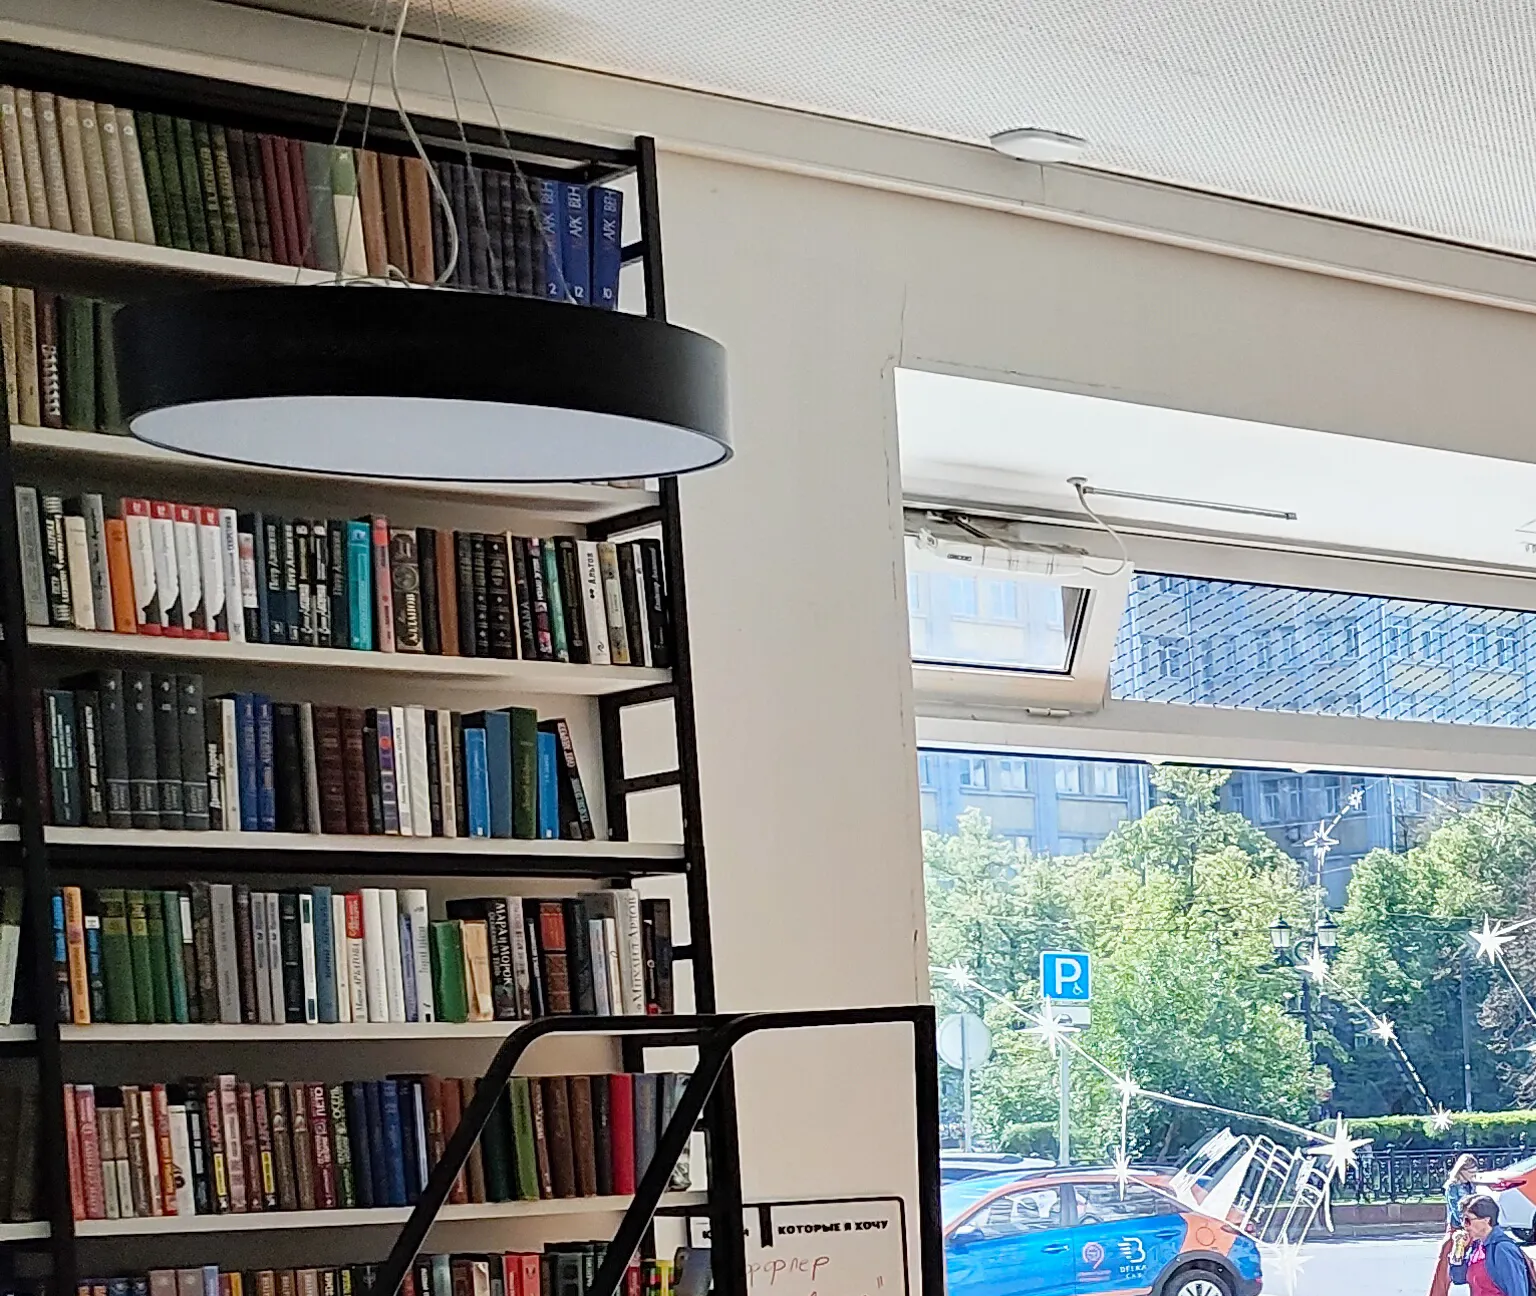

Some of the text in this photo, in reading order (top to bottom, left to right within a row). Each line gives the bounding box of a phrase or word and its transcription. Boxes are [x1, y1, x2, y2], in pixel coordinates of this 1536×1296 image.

[548, 282, 557, 295] 2
[1055, 958, 1082, 994] P
[314, 1086, 326, 1116] ЛЕТО
[778, 1220, 888, 1235] КОТОРЫЕ Я ХОЧУ
